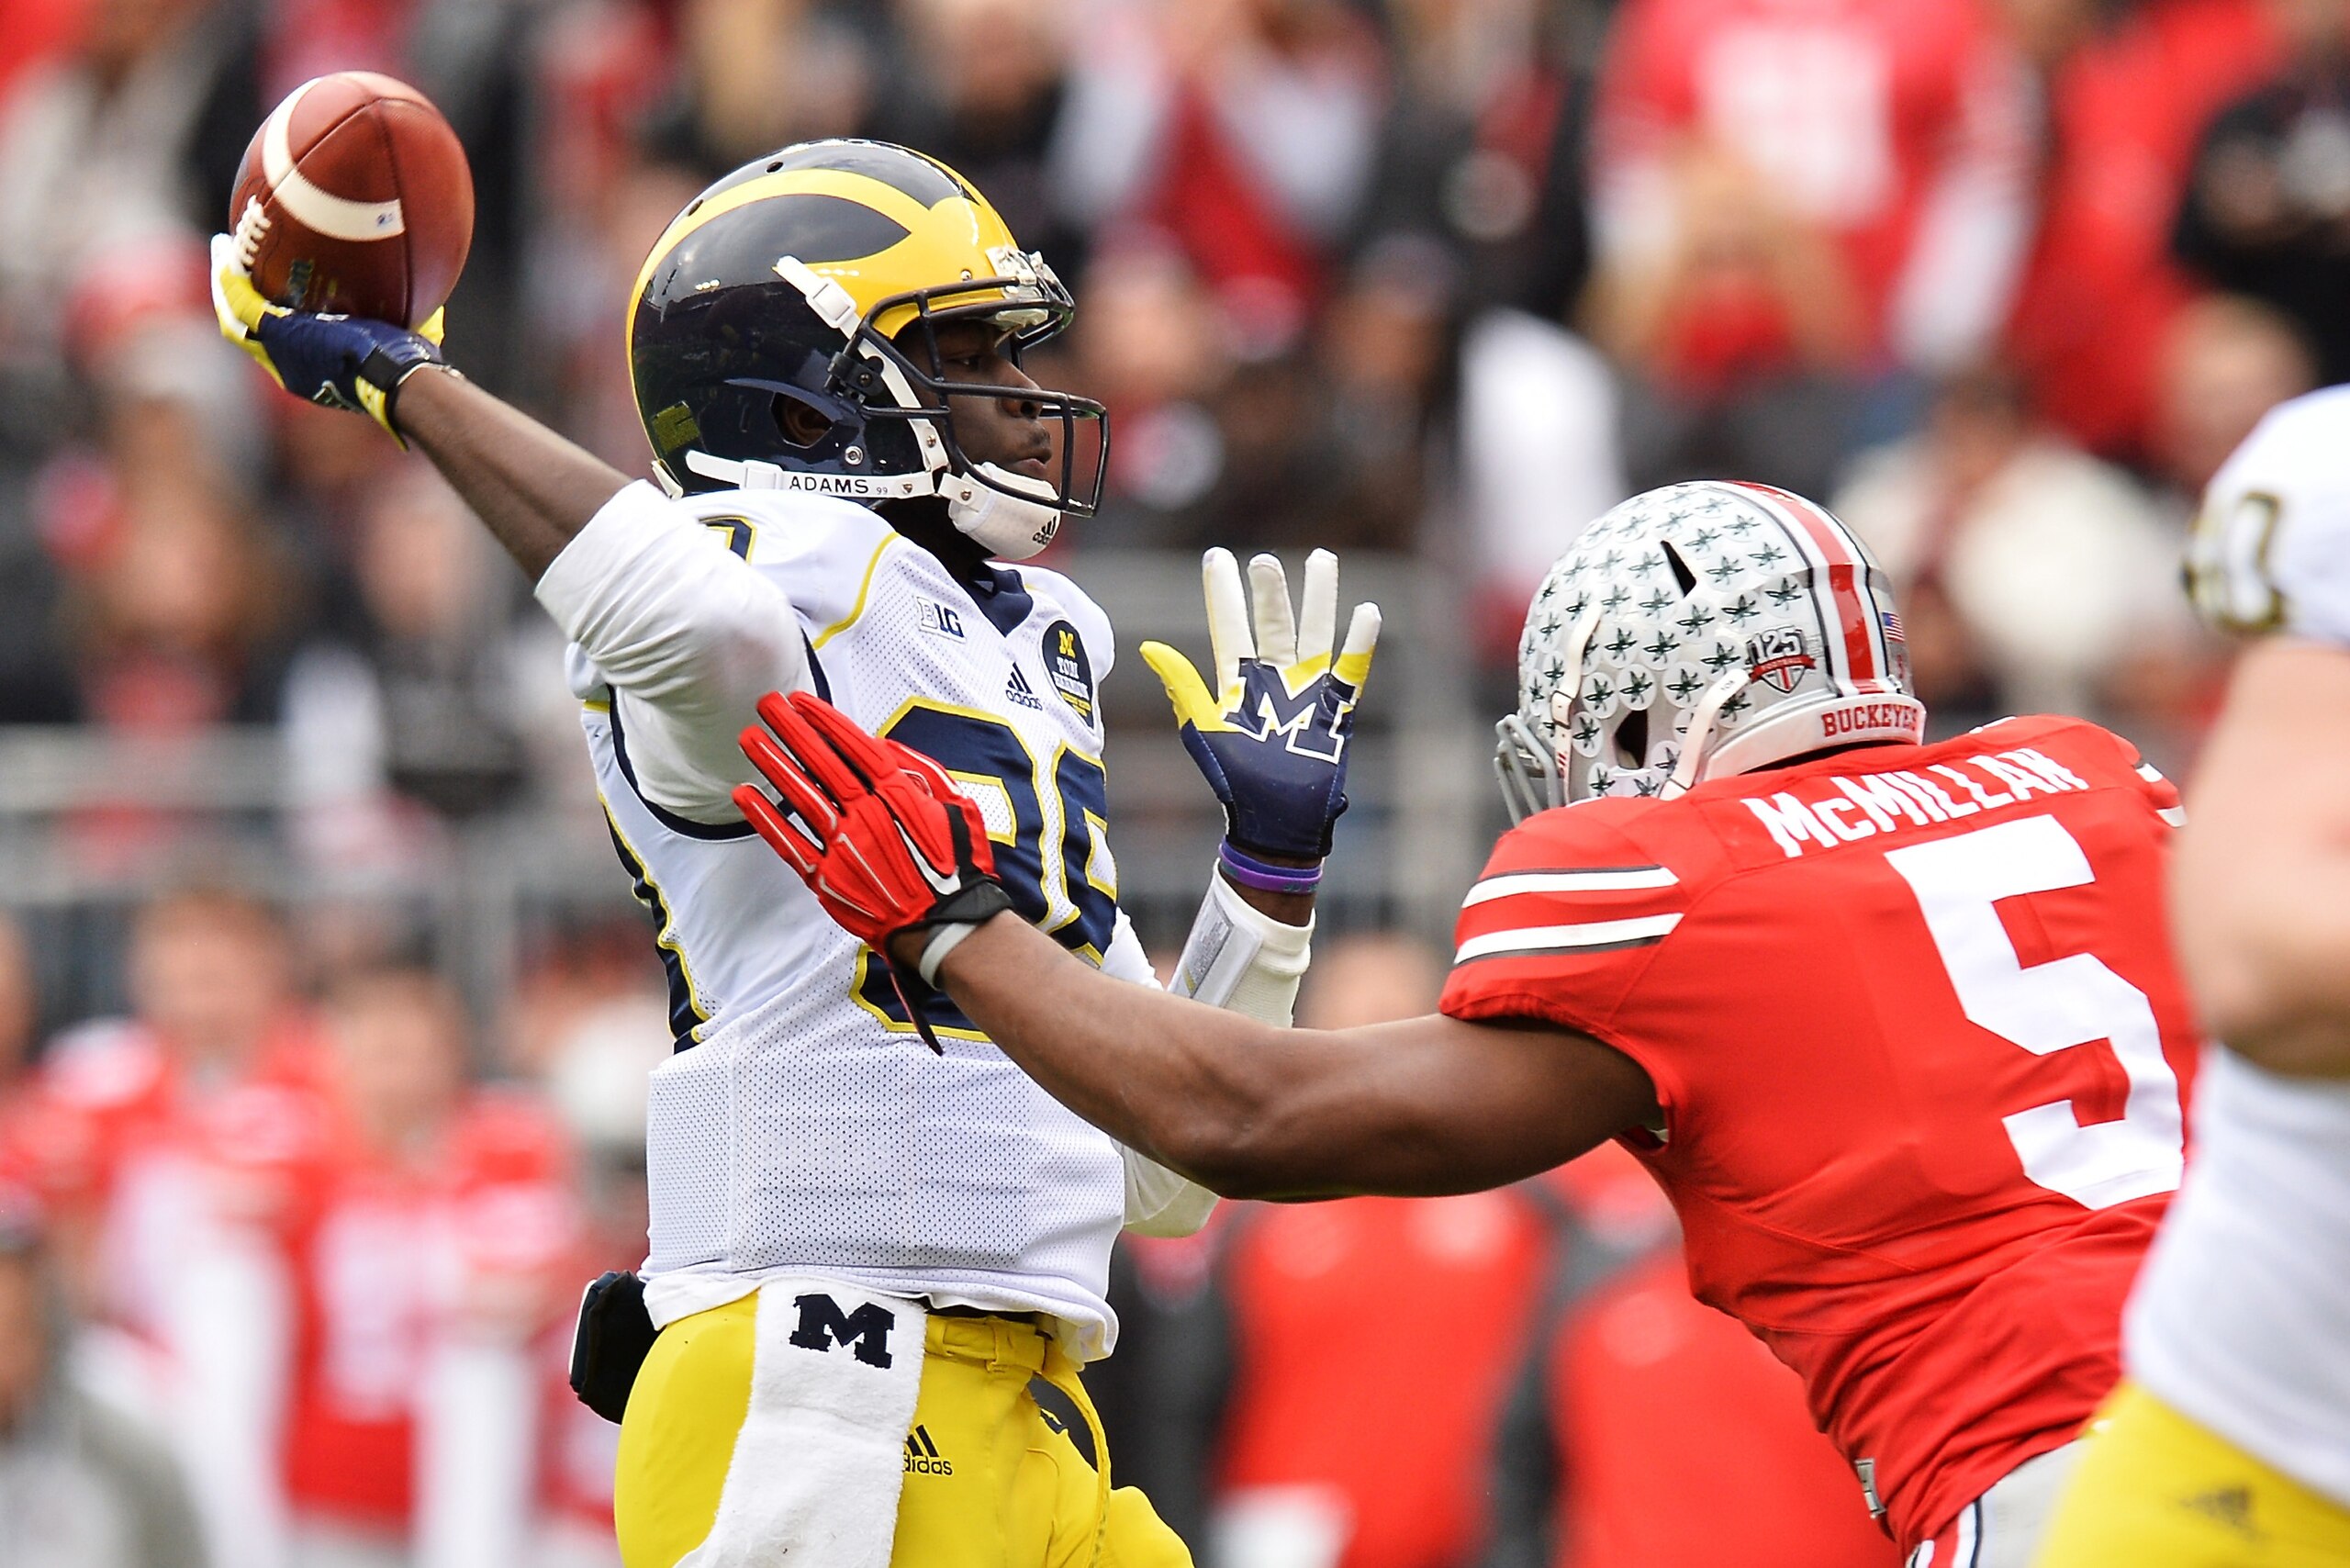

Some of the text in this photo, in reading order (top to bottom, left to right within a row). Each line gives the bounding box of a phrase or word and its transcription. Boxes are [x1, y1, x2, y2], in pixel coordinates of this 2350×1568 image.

[789, 476, 869, 494] ADAMS
[1058, 630, 1076, 659] M
[1748, 625, 1802, 664] 125
[1005, 689, 1043, 711] adidas
[1223, 657, 1357, 765] M
[1884, 813, 2185, 1211] 5
[789, 1294, 896, 1370] M
[902, 1453, 953, 1476] didas
